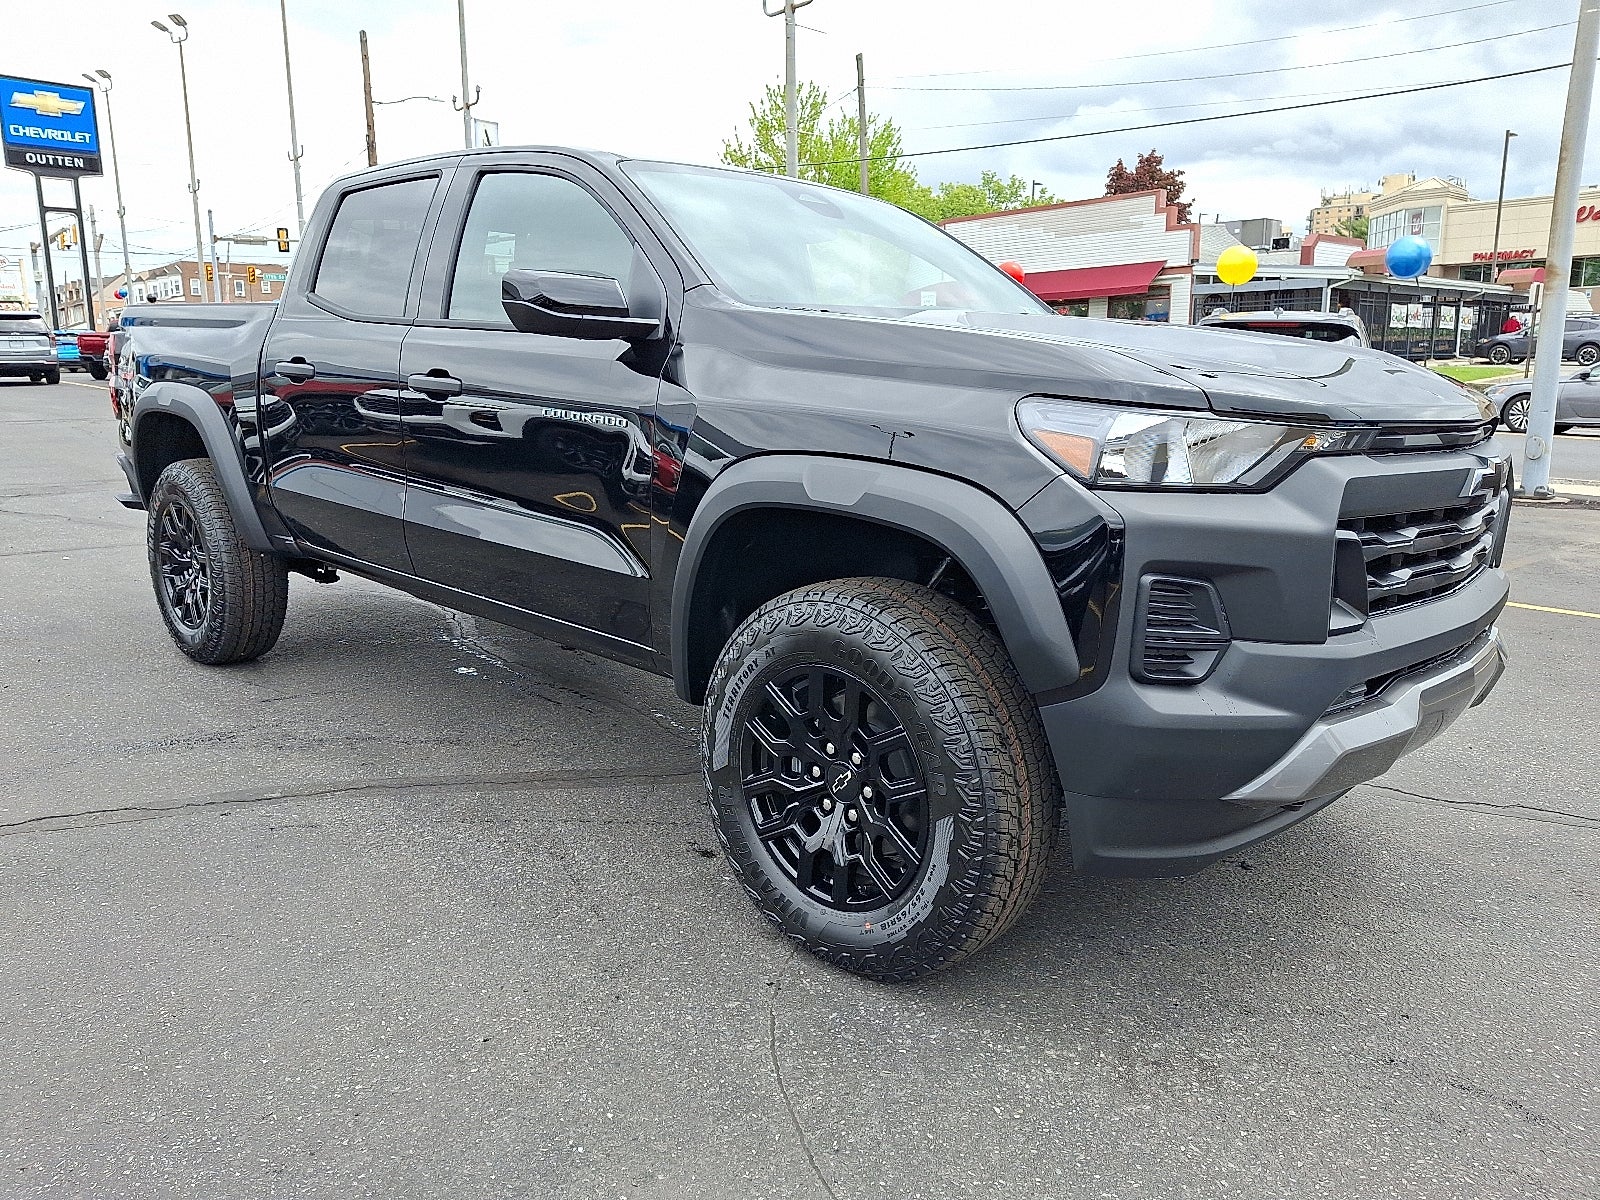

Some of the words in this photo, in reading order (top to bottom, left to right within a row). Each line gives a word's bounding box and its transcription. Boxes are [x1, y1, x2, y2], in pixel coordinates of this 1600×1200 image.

[9, 124, 92, 143] CHEVROLET
[25, 152, 84, 168] OUTTEN
[1472, 248, 1537, 262] PHARMACY
[542, 408, 629, 428] COLORADO
[722, 657, 760, 720] TERRITORY
[763, 646, 777, 660] AT
[880, 887, 926, 932] 265/65R18
